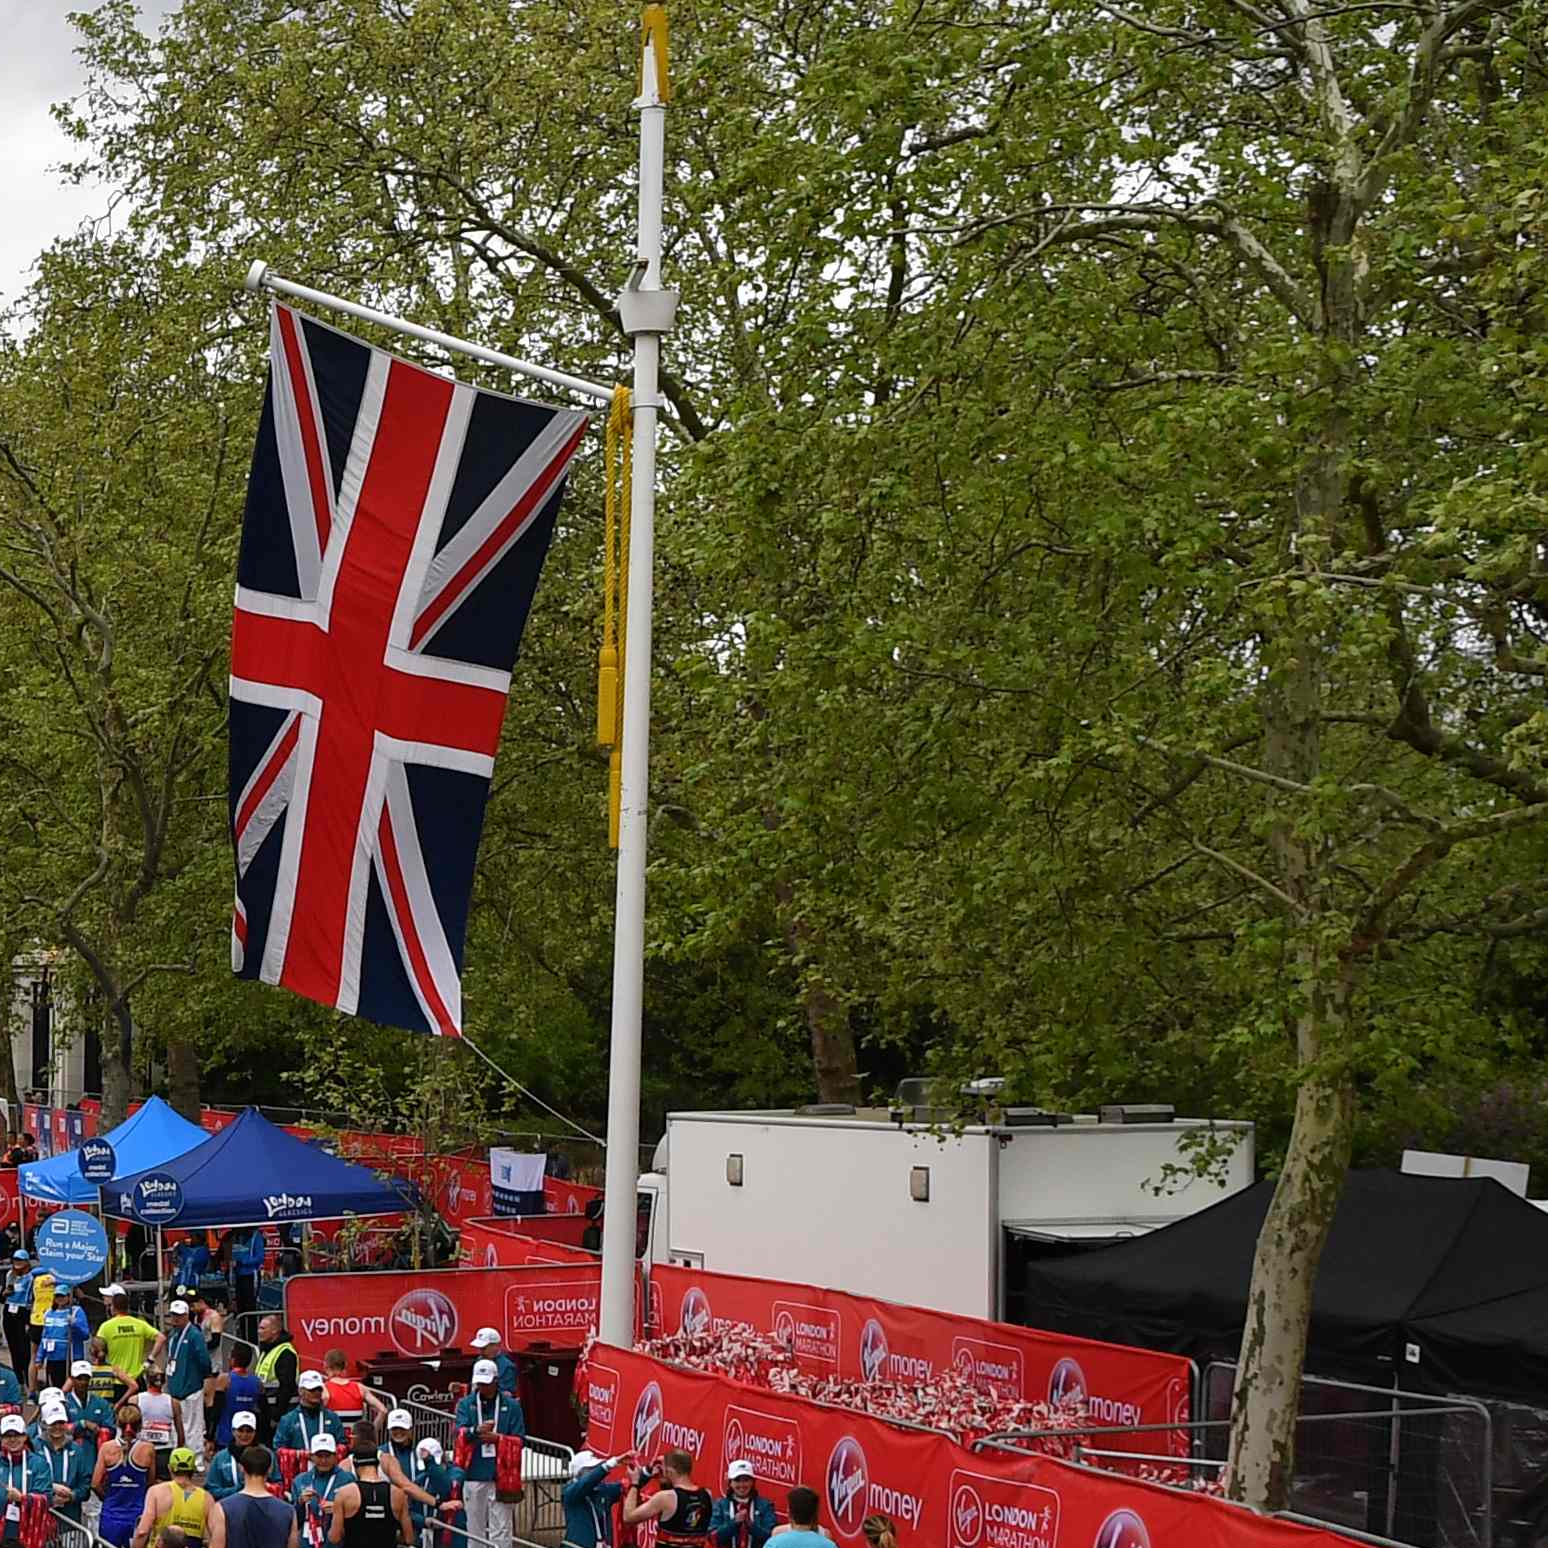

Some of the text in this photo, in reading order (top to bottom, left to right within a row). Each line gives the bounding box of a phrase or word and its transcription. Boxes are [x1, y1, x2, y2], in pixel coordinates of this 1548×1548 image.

[140, 1179, 177, 1198] London
[263, 1192, 312, 1218] London
[39, 1246, 65, 1258] Claim
[65, 1251, 86, 1262] your
[45, 1237, 62, 1250] Run
[889, 1353, 934, 1382] money
[1088, 1395, 1143, 1429] money
[663, 1420, 705, 1460] money
[744, 1433, 782, 1457] LONDON
[831, 1449, 923, 1531] Virgin money
[984, 1502, 1038, 1531] LONDON
